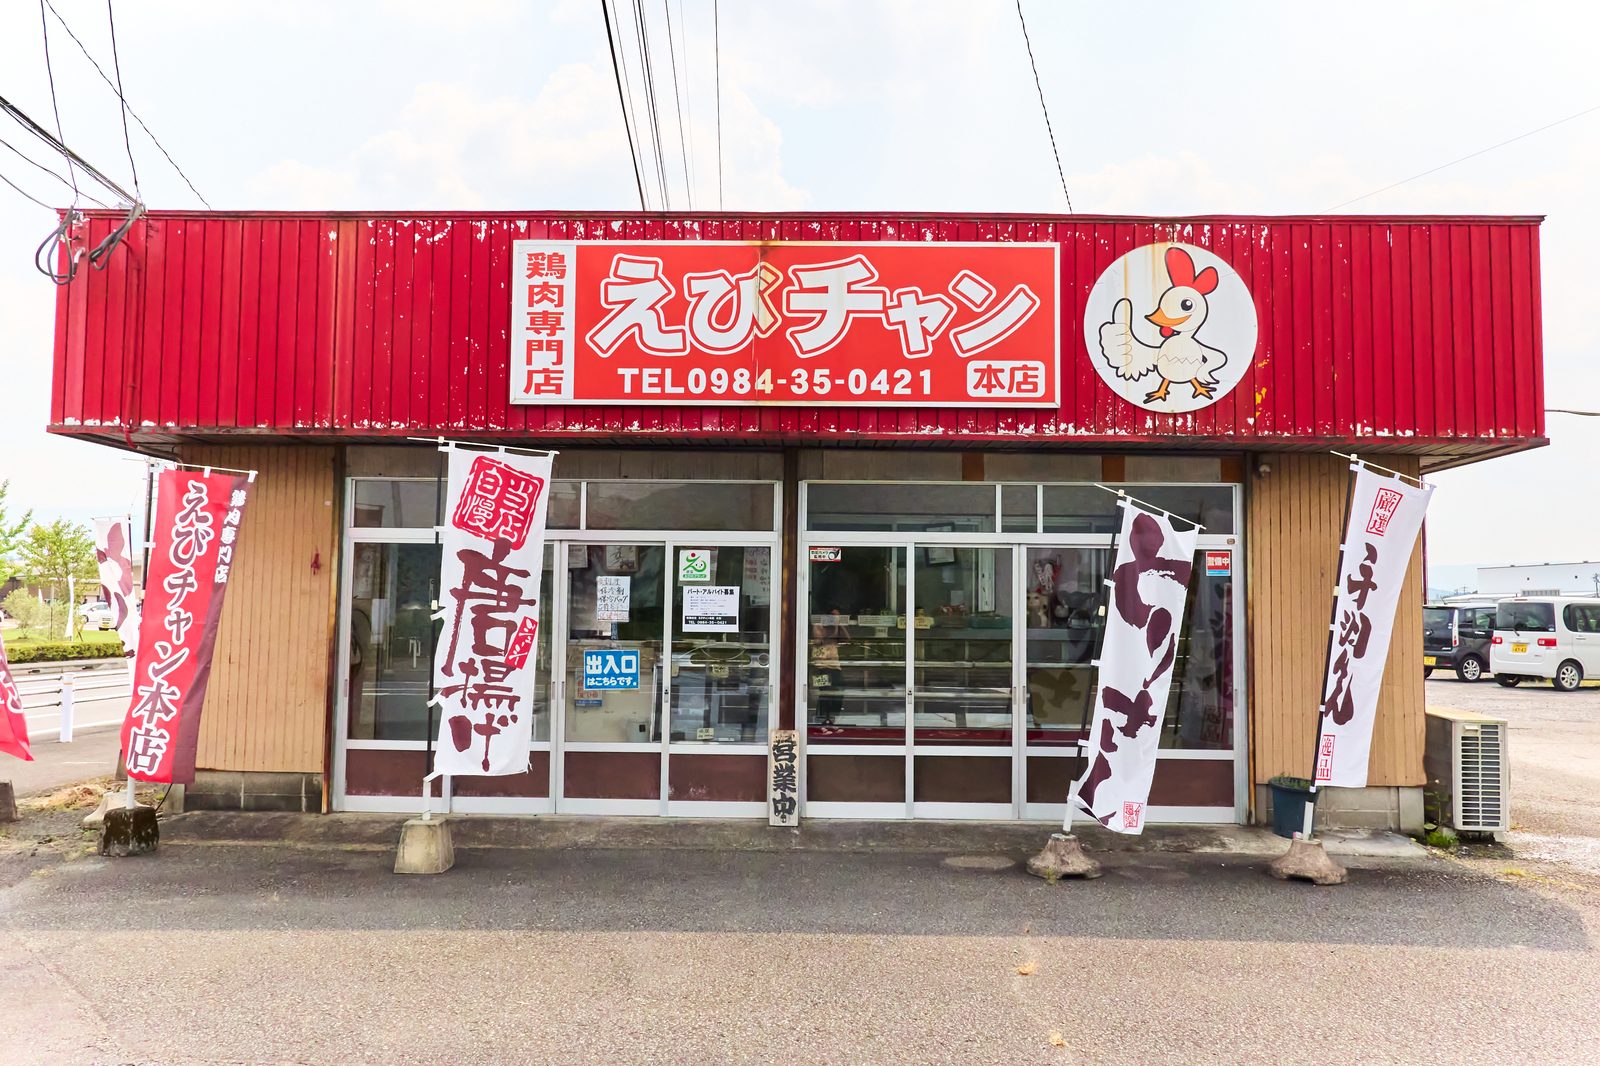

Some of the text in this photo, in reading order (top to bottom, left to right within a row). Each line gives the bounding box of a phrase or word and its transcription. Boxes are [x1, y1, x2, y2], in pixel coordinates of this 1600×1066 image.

[523, 251, 567, 396] 鶏肉専門店
[586, 253, 1041, 358] えびチャン
[972, 363, 1040, 395] 本店
[126, 480, 215, 775] えびチャン本店
[687, 588, 735, 596] パート・アルバイト募集
[440, 537, 537, 773] 唐揚げ
[586, 654, 637, 675] 出入口
[586, 676, 638, 687] はこちらです。
[772, 733, 798, 824] 営業中
